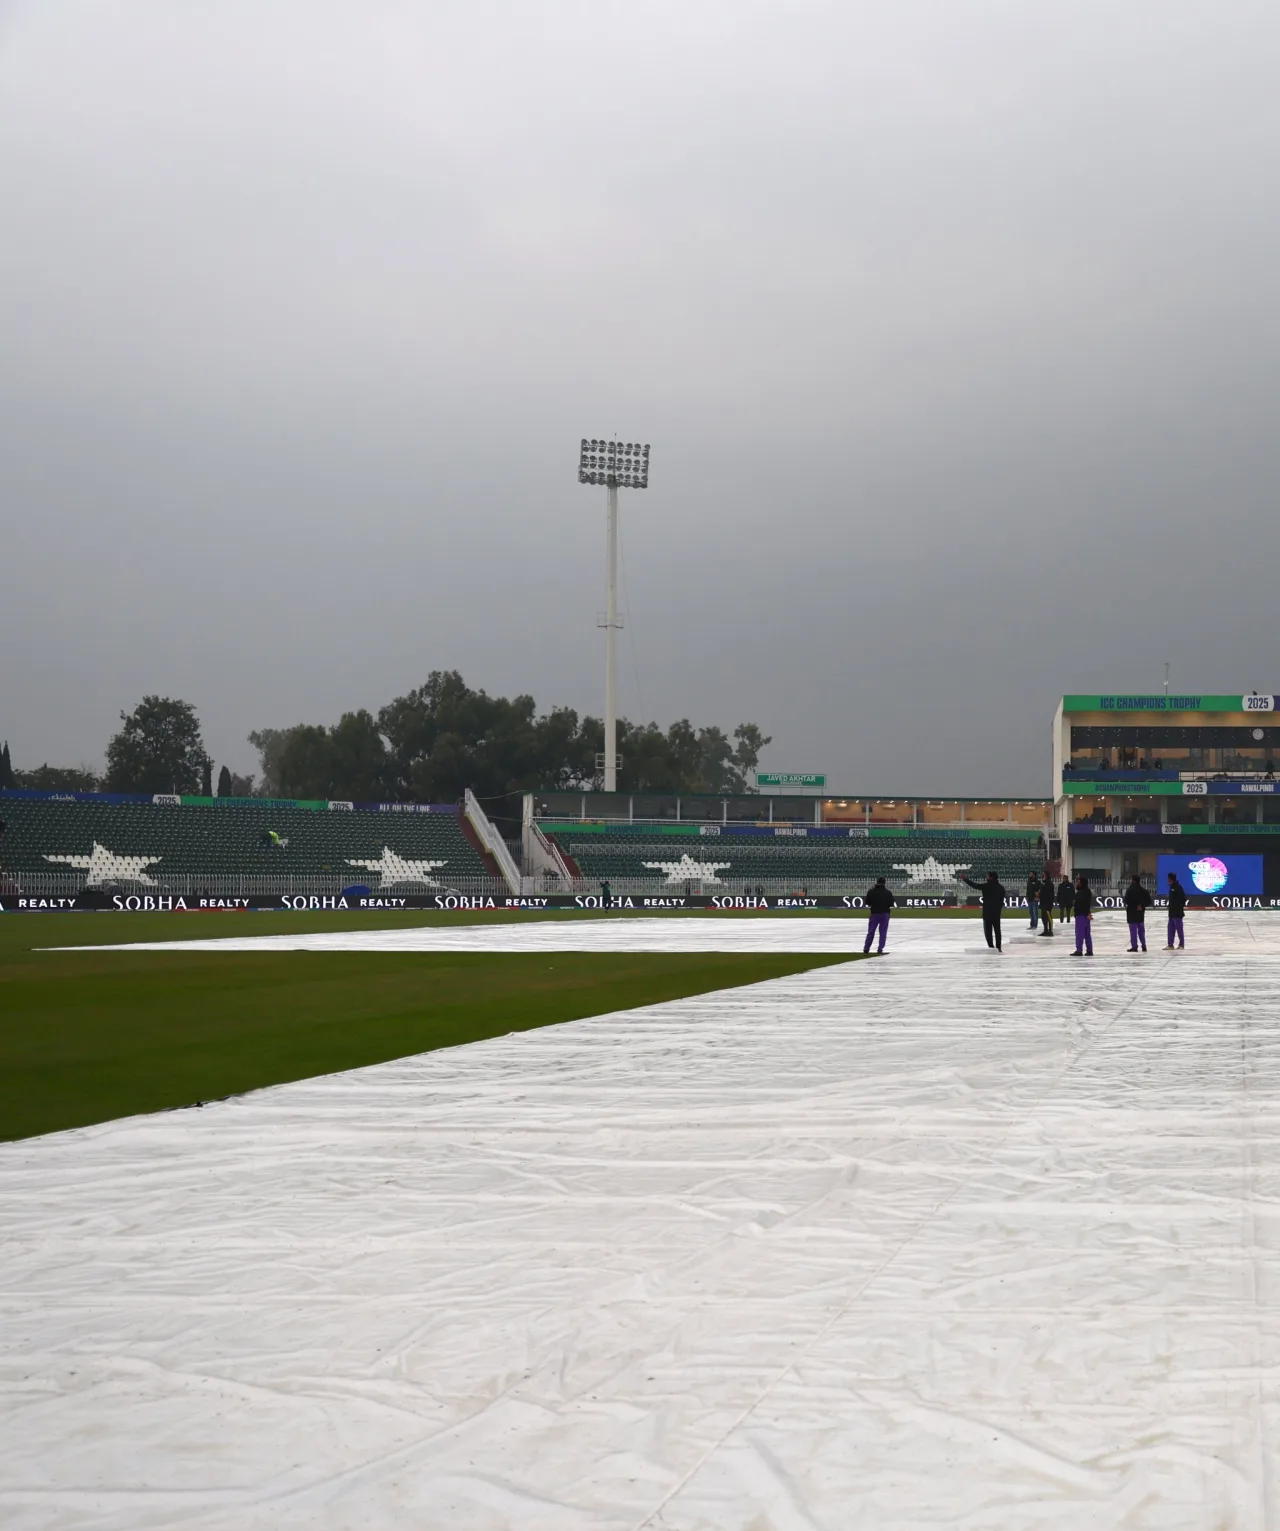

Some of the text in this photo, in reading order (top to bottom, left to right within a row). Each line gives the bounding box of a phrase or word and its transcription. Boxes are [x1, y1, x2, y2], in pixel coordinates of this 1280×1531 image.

[1100, 697, 1114, 709] ICC
[1117, 697, 1166, 709] CHAMPIONS
[1169, 697, 1201, 709] TROPHY
[1248, 697, 1269, 709] 2025
[766, 774, 816, 783] JAVED AKHTAR
[1186, 783, 1204, 793] 2025
[1241, 784, 1275, 792] RAWALPINDI
[774, 828, 808, 836] RAWALPINDI
[1094, 825, 1106, 833] ALL
[1104, 825, 1114, 833] ON
[1113, 825, 1124, 833] THE
[1124, 825, 1136, 833] LINE
[1165, 825, 1179, 834] 2025
[18, 898, 76, 908] REALTY
[112, 895, 249, 911] SOBHA REALTY
[281, 895, 348, 910] SOBHA
[359, 898, 405, 907] REALTY
[434, 895, 548, 909] SOBHA REALTY
[643, 898, 685, 906] REALTY
[711, 896, 818, 908] SOBHA REALTY
[906, 898, 945, 906] REALTY
[1095, 896, 1128, 908] SOB
[1212, 896, 1262, 908] SOBHA
